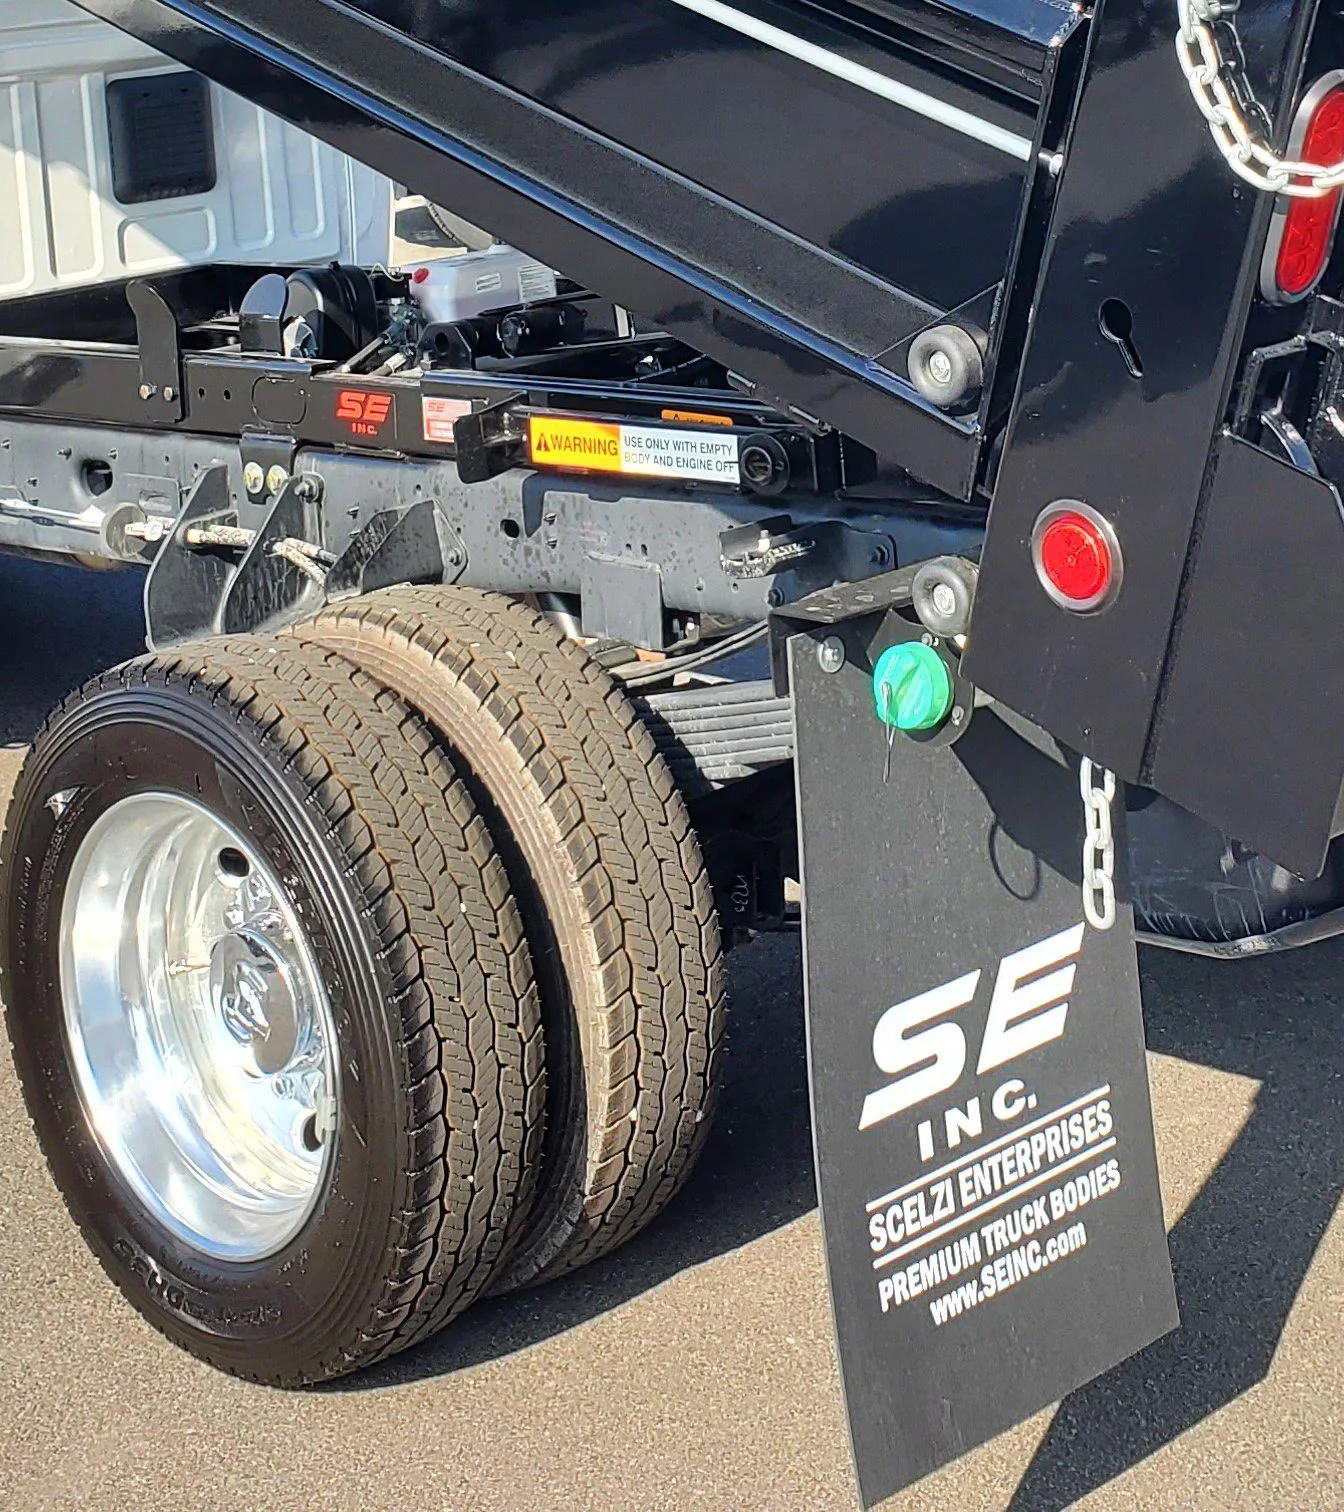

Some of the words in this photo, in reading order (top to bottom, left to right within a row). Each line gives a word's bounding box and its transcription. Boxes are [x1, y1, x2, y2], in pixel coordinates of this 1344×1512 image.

[336, 391, 392, 422] SE
[427, 401, 446, 413] SE
[351, 423, 378, 436] INC.
[550, 433, 619, 456] WARNING
[624, 435, 643, 448] USE
[645, 438, 670, 451] ONLY
[672, 440, 697, 453] WITH
[700, 442, 733, 456] EMPTY
[624, 451, 650, 464] BODY
[653, 455, 673, 467] AND
[676, 457, 713, 471] ENGINE
[715, 460, 735, 472] OFF
[858, 921, 1085, 1131] SE
[917, 1078, 1037, 1162] INC.
[869, 1177, 956, 1253] SCELZI
[958, 1099, 1113, 1208] ENTERPRISES
[878, 1232, 981, 1313] PREMIUM
[981, 1199, 1050, 1257] TRUCK
[1050, 1158, 1122, 1220] BODIES
[930, 1221, 1088, 1326] www.SEINC.com
